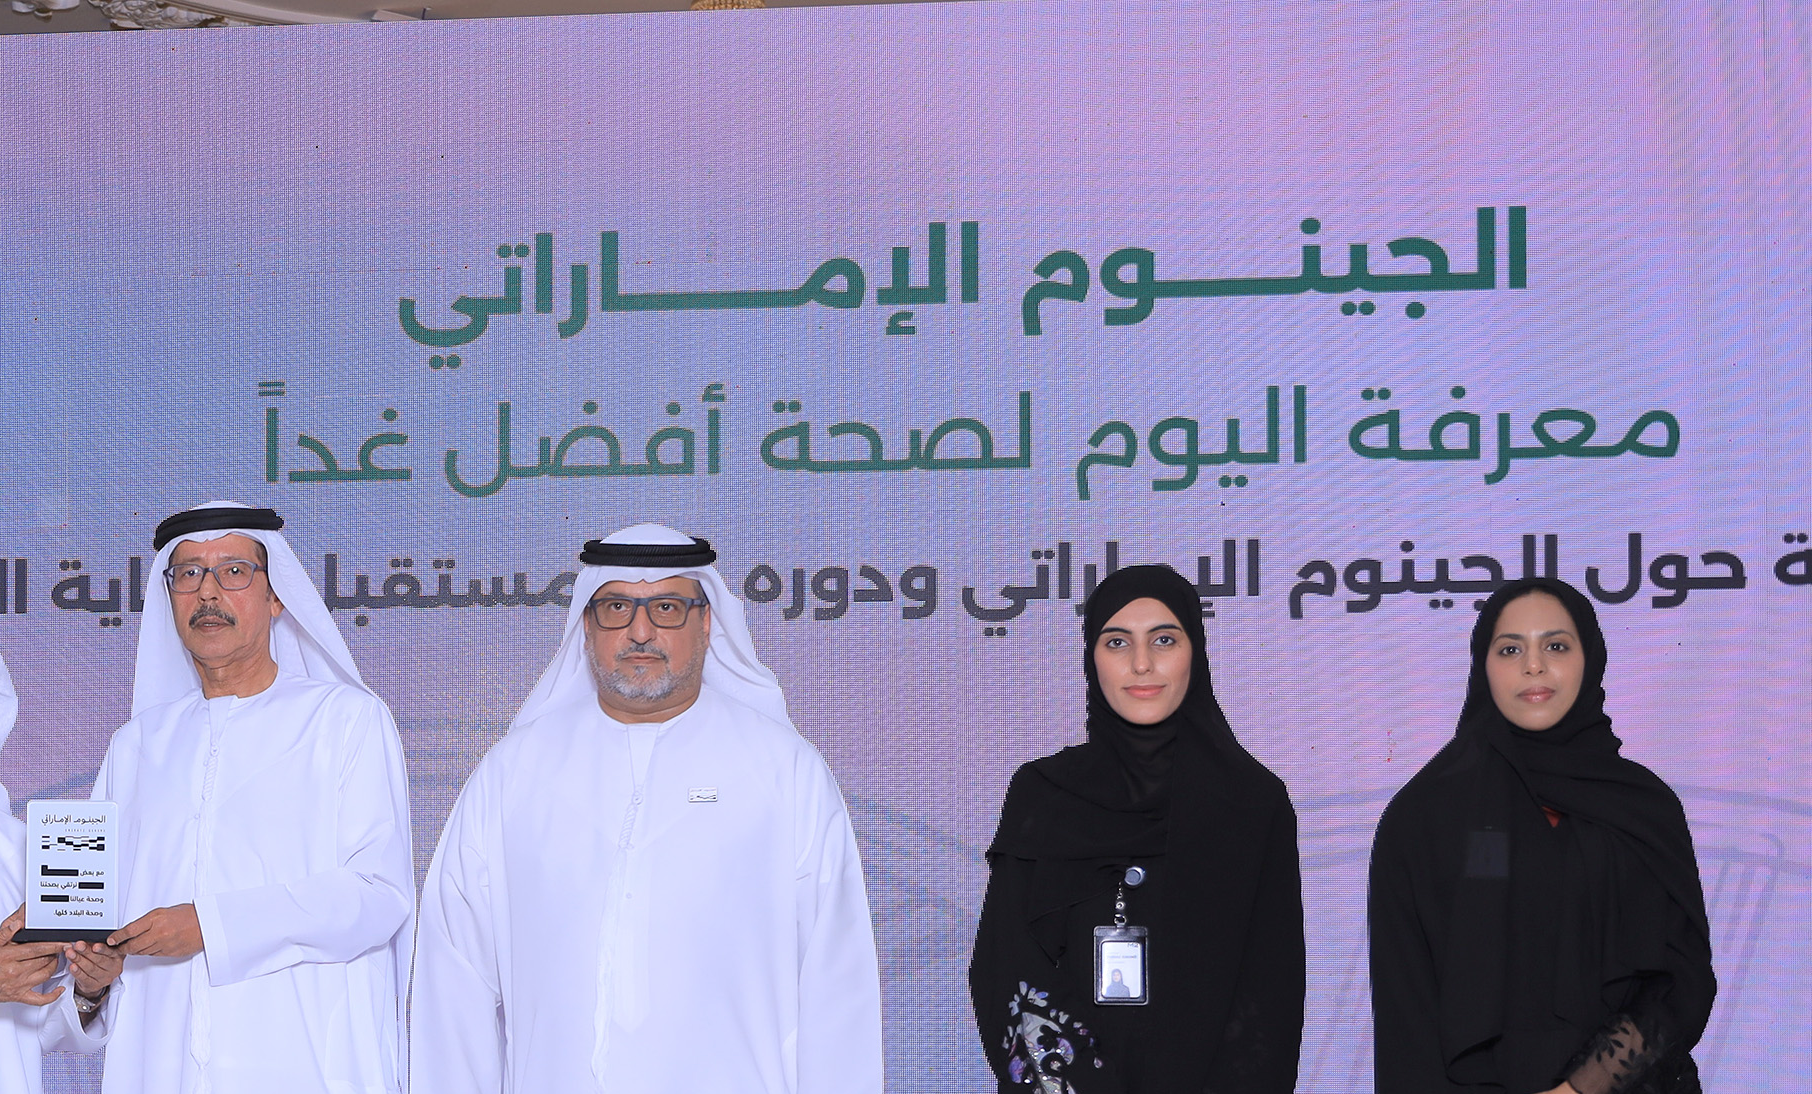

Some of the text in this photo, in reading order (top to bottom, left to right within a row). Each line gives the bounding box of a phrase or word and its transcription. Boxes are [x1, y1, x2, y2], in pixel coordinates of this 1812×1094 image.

[399, 206, 1527, 369] الجينوم الإماراتي
[445, 384, 724, 498] أفضل
[761, 391, 1031, 474] لصحة
[1077, 385, 1307, 500] اليوم
[1349, 386, 1680, 485] معرفة
[743, 563, 938, 621] ودوره
[961, 538, 1260, 637] الإراتي
[1289, 534, 1558, 620] الجينوم
[1585, 532, 1747, 609] حول
